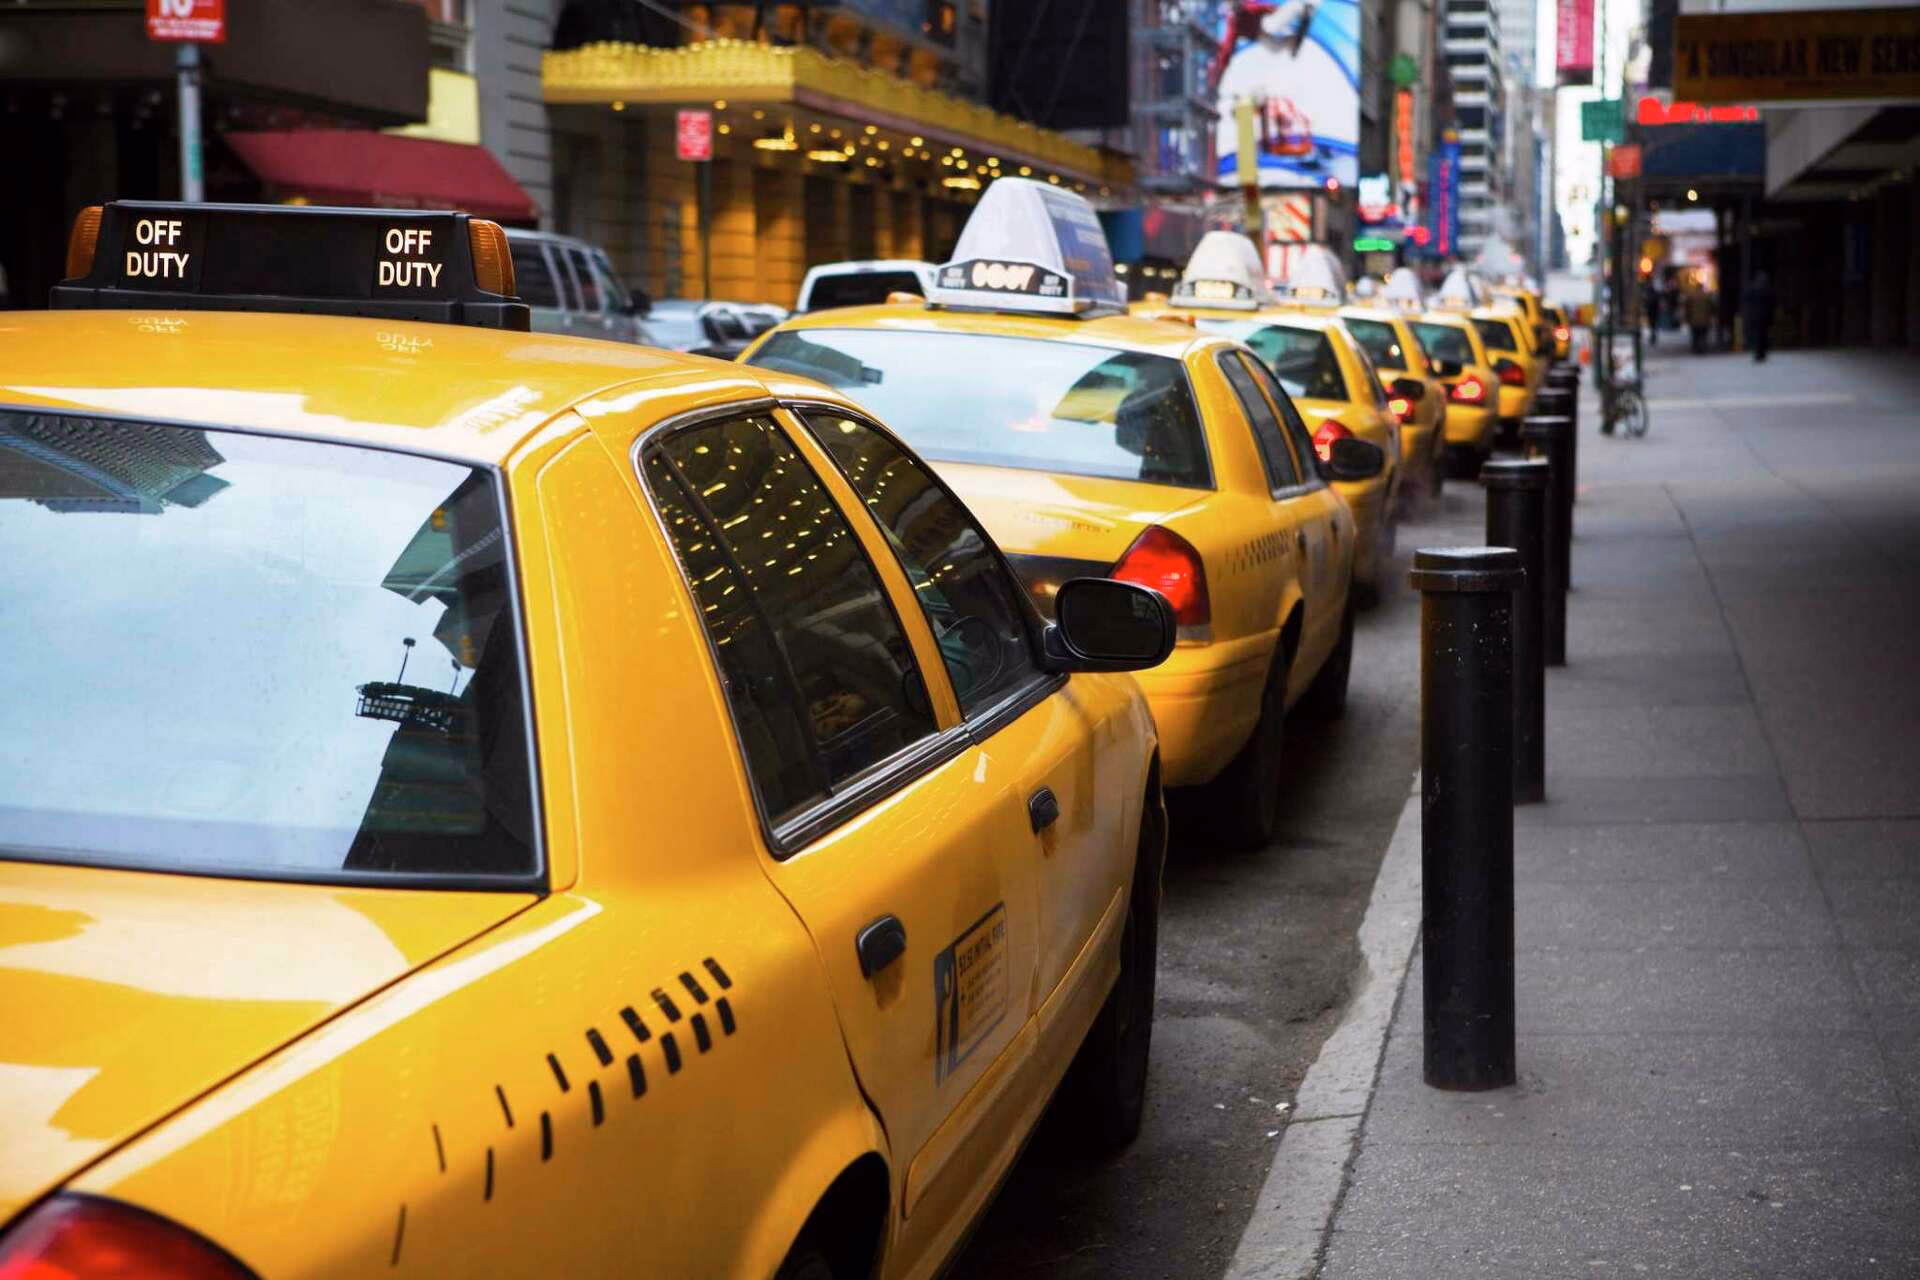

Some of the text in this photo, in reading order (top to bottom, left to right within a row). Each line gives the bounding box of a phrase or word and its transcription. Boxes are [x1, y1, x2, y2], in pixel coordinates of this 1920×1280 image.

[1816, 34, 1862, 74] NEW
[135, 219, 182, 246] OFF
[385, 228, 432, 255] OFF
[126, 251, 189, 279] DUTY
[378, 260, 443, 288] DUTY
